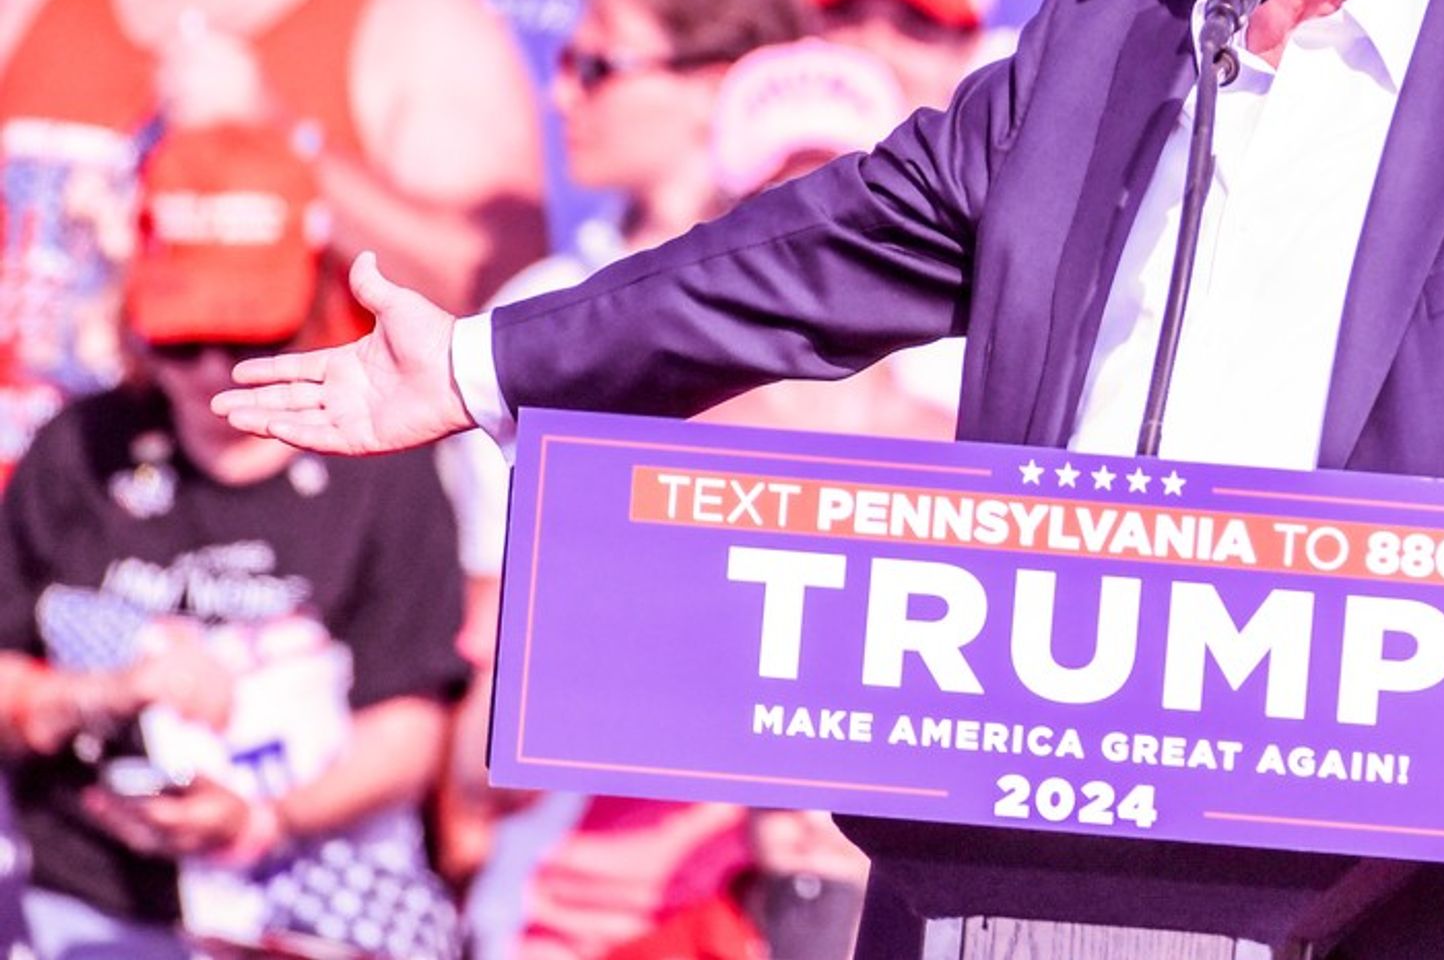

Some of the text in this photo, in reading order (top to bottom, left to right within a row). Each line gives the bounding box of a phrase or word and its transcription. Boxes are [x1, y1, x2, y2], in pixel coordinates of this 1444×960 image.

[656, 473, 802, 528] TEXT
[816, 486, 1257, 565] PENNSYLVANIA
[1273, 522, 1350, 572] TO
[752, 703, 1410, 785] MAKE AMERICA GREAT AGAIN!
[994, 774, 1157, 828] 2024
